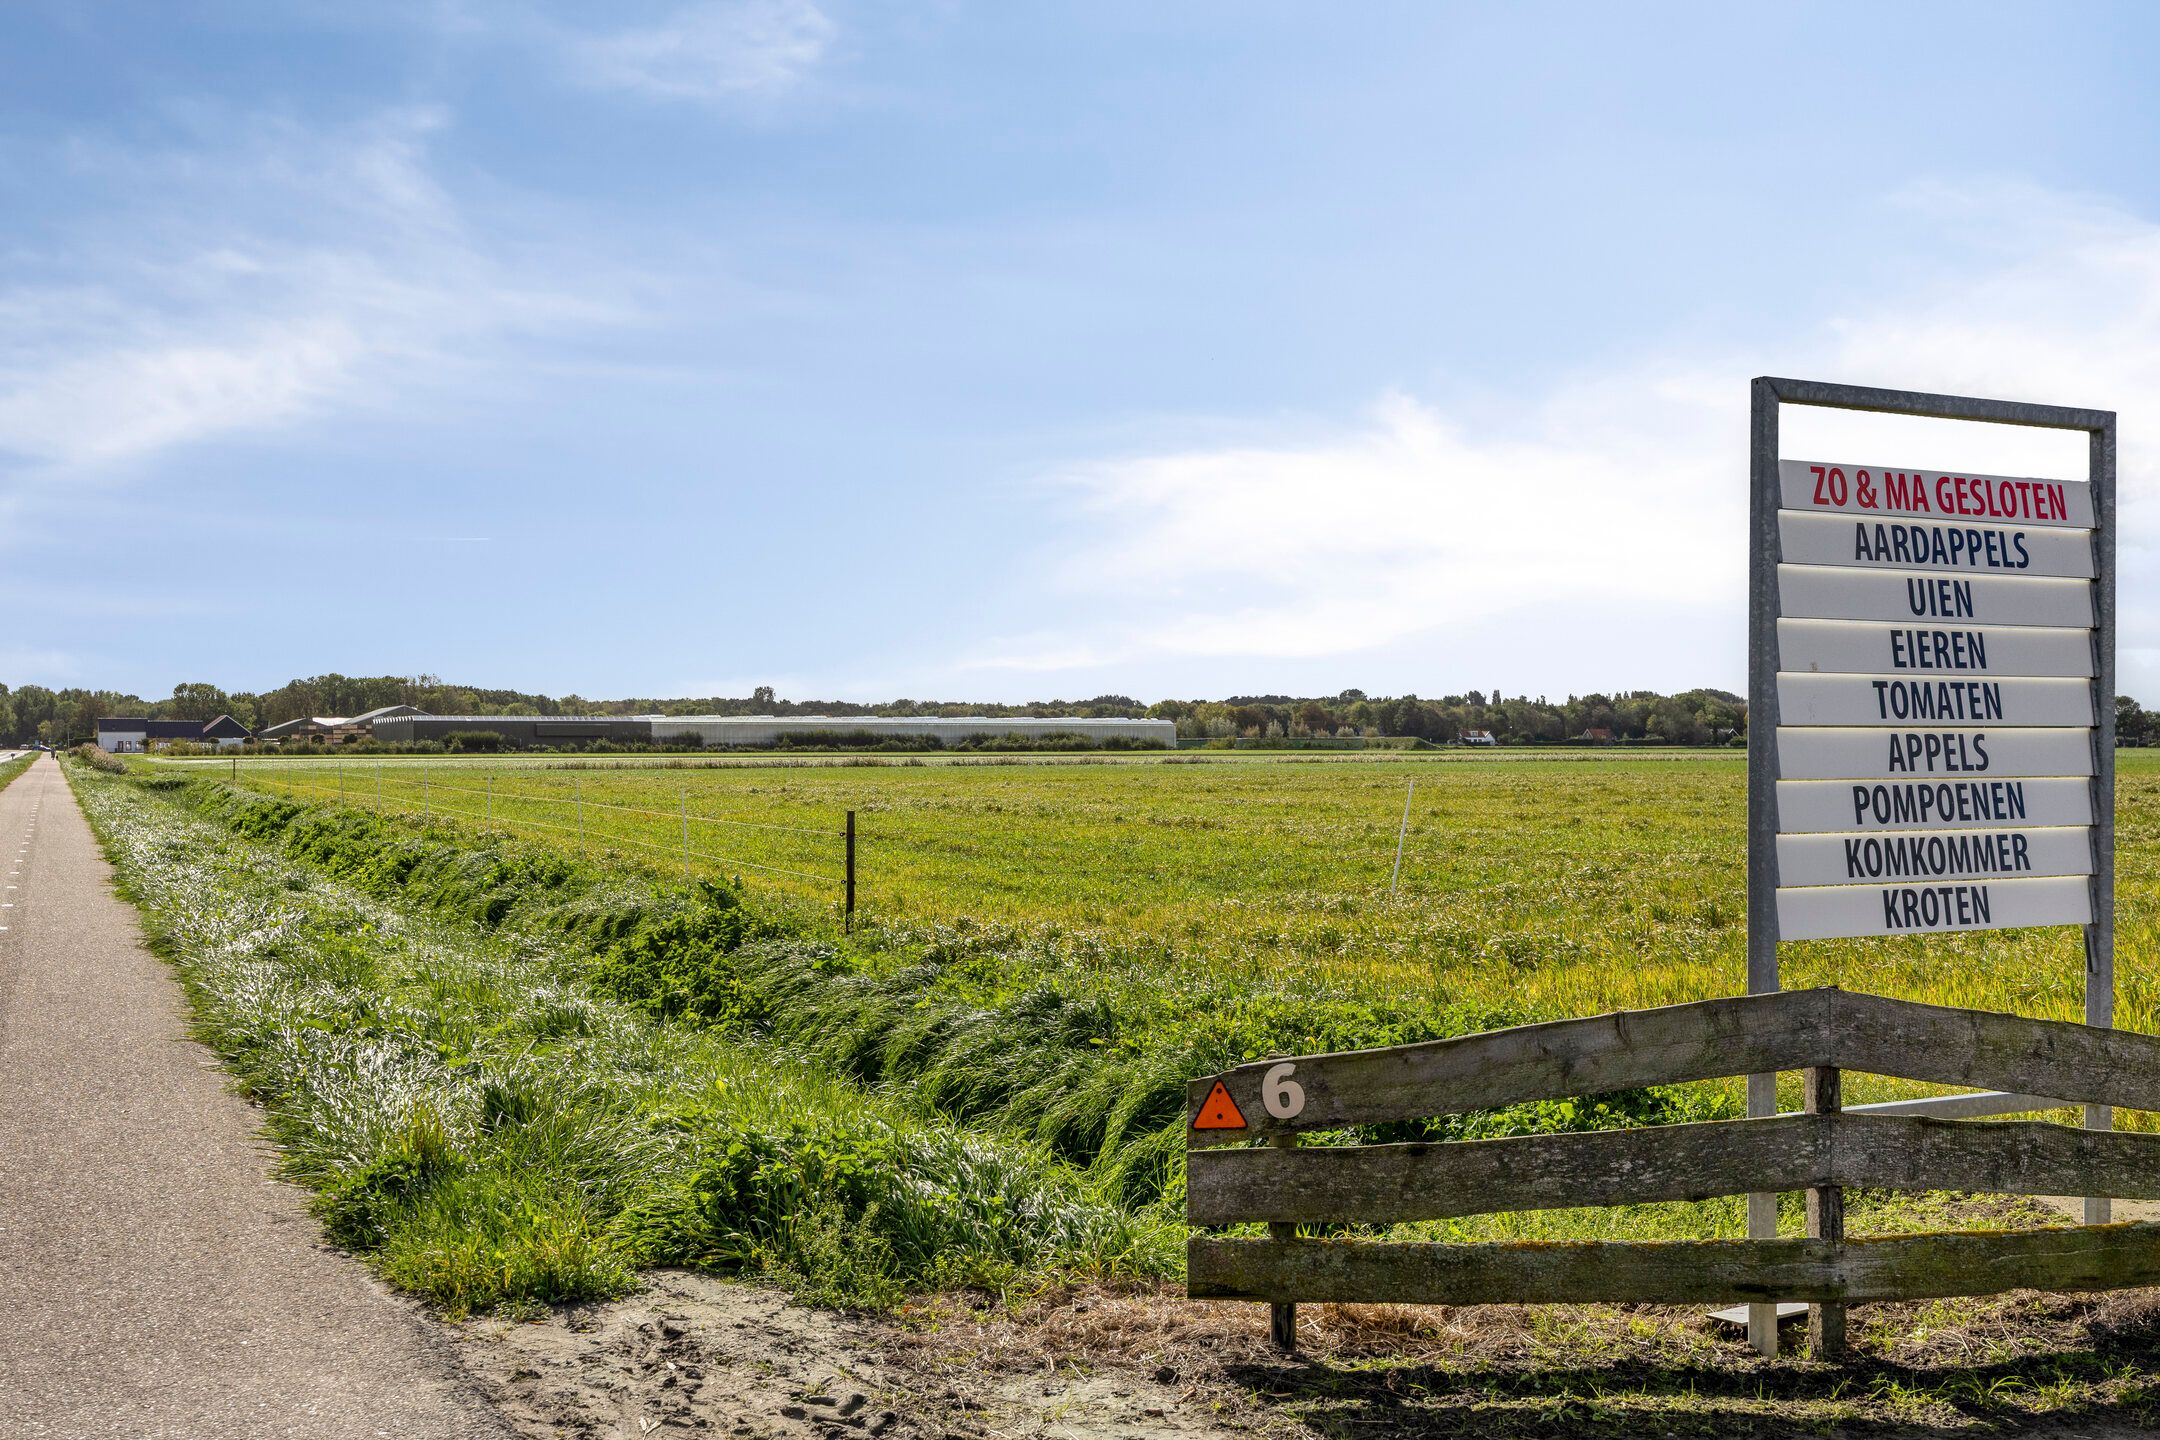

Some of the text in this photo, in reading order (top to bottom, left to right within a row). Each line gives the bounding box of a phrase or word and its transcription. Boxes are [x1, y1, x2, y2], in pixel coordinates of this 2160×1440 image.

[1810, 466, 2067, 520] ZO & MA GESLOTEN
[1855, 522, 2029, 569] AARDAPPELS
[1908, 578, 1973, 618] UIEN
[1891, 630, 1986, 670] EIEREN
[1872, 681, 2003, 720] TOMATEN
[1889, 733, 1989, 772] APPELS
[1853, 782, 2026, 825] POMPOENEN
[1845, 834, 2031, 879] KOMKOMMER
[1882, 885, 1991, 928] KROTEN
[1262, 1063, 1305, 1119] 6
